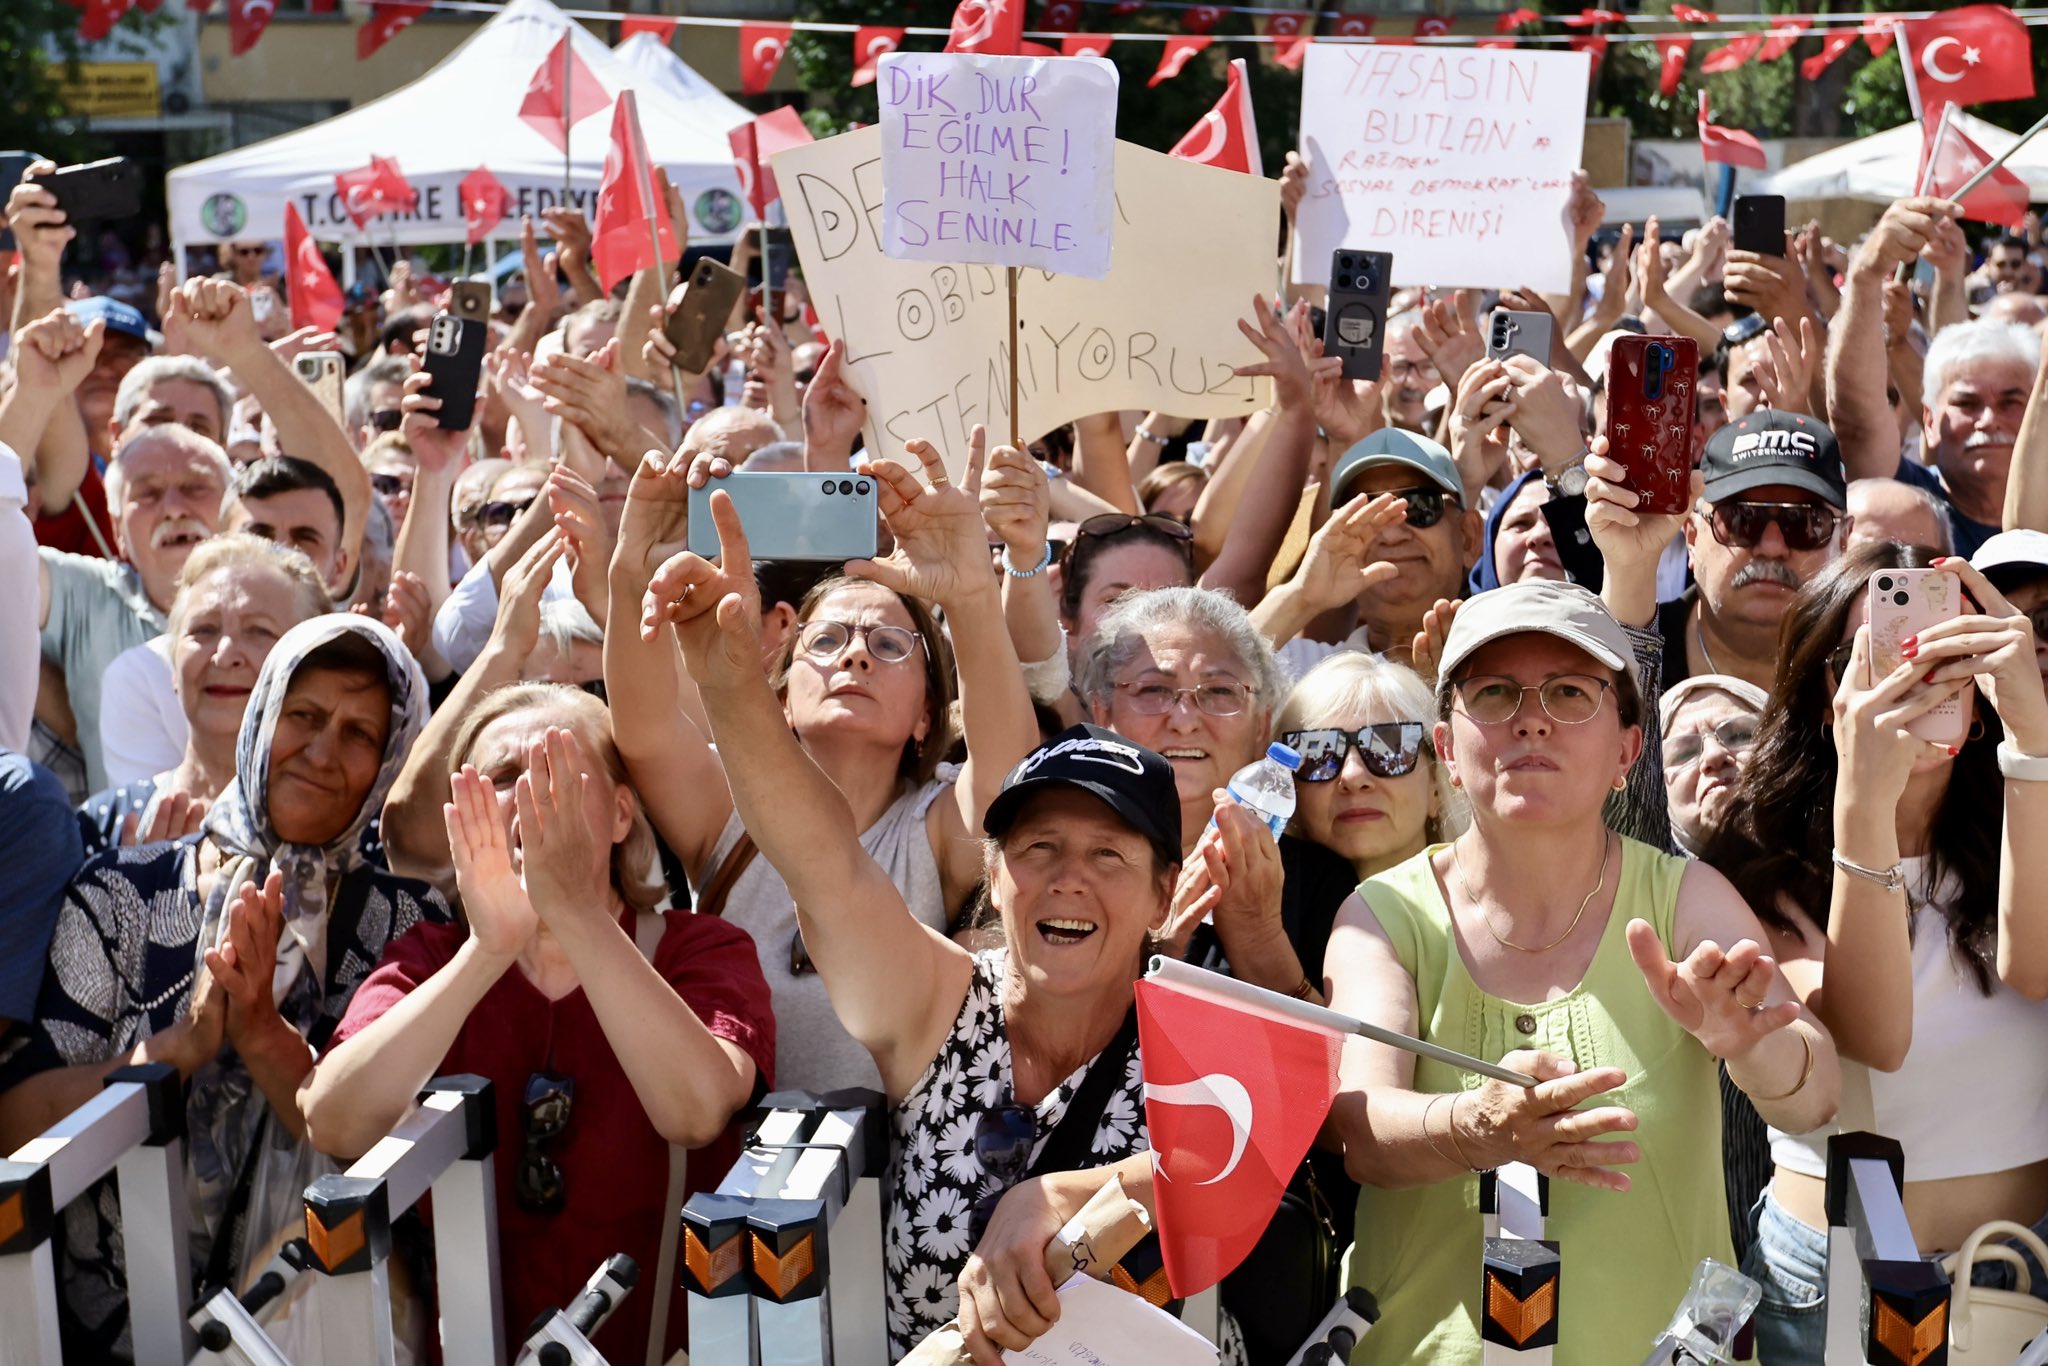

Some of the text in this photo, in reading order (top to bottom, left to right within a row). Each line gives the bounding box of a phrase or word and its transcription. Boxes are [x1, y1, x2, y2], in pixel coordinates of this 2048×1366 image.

[888, 65, 1042, 122] DİK DUR
[1343, 49, 1538, 103] YAŞASIN
[939, 160, 1036, 211] HALK
